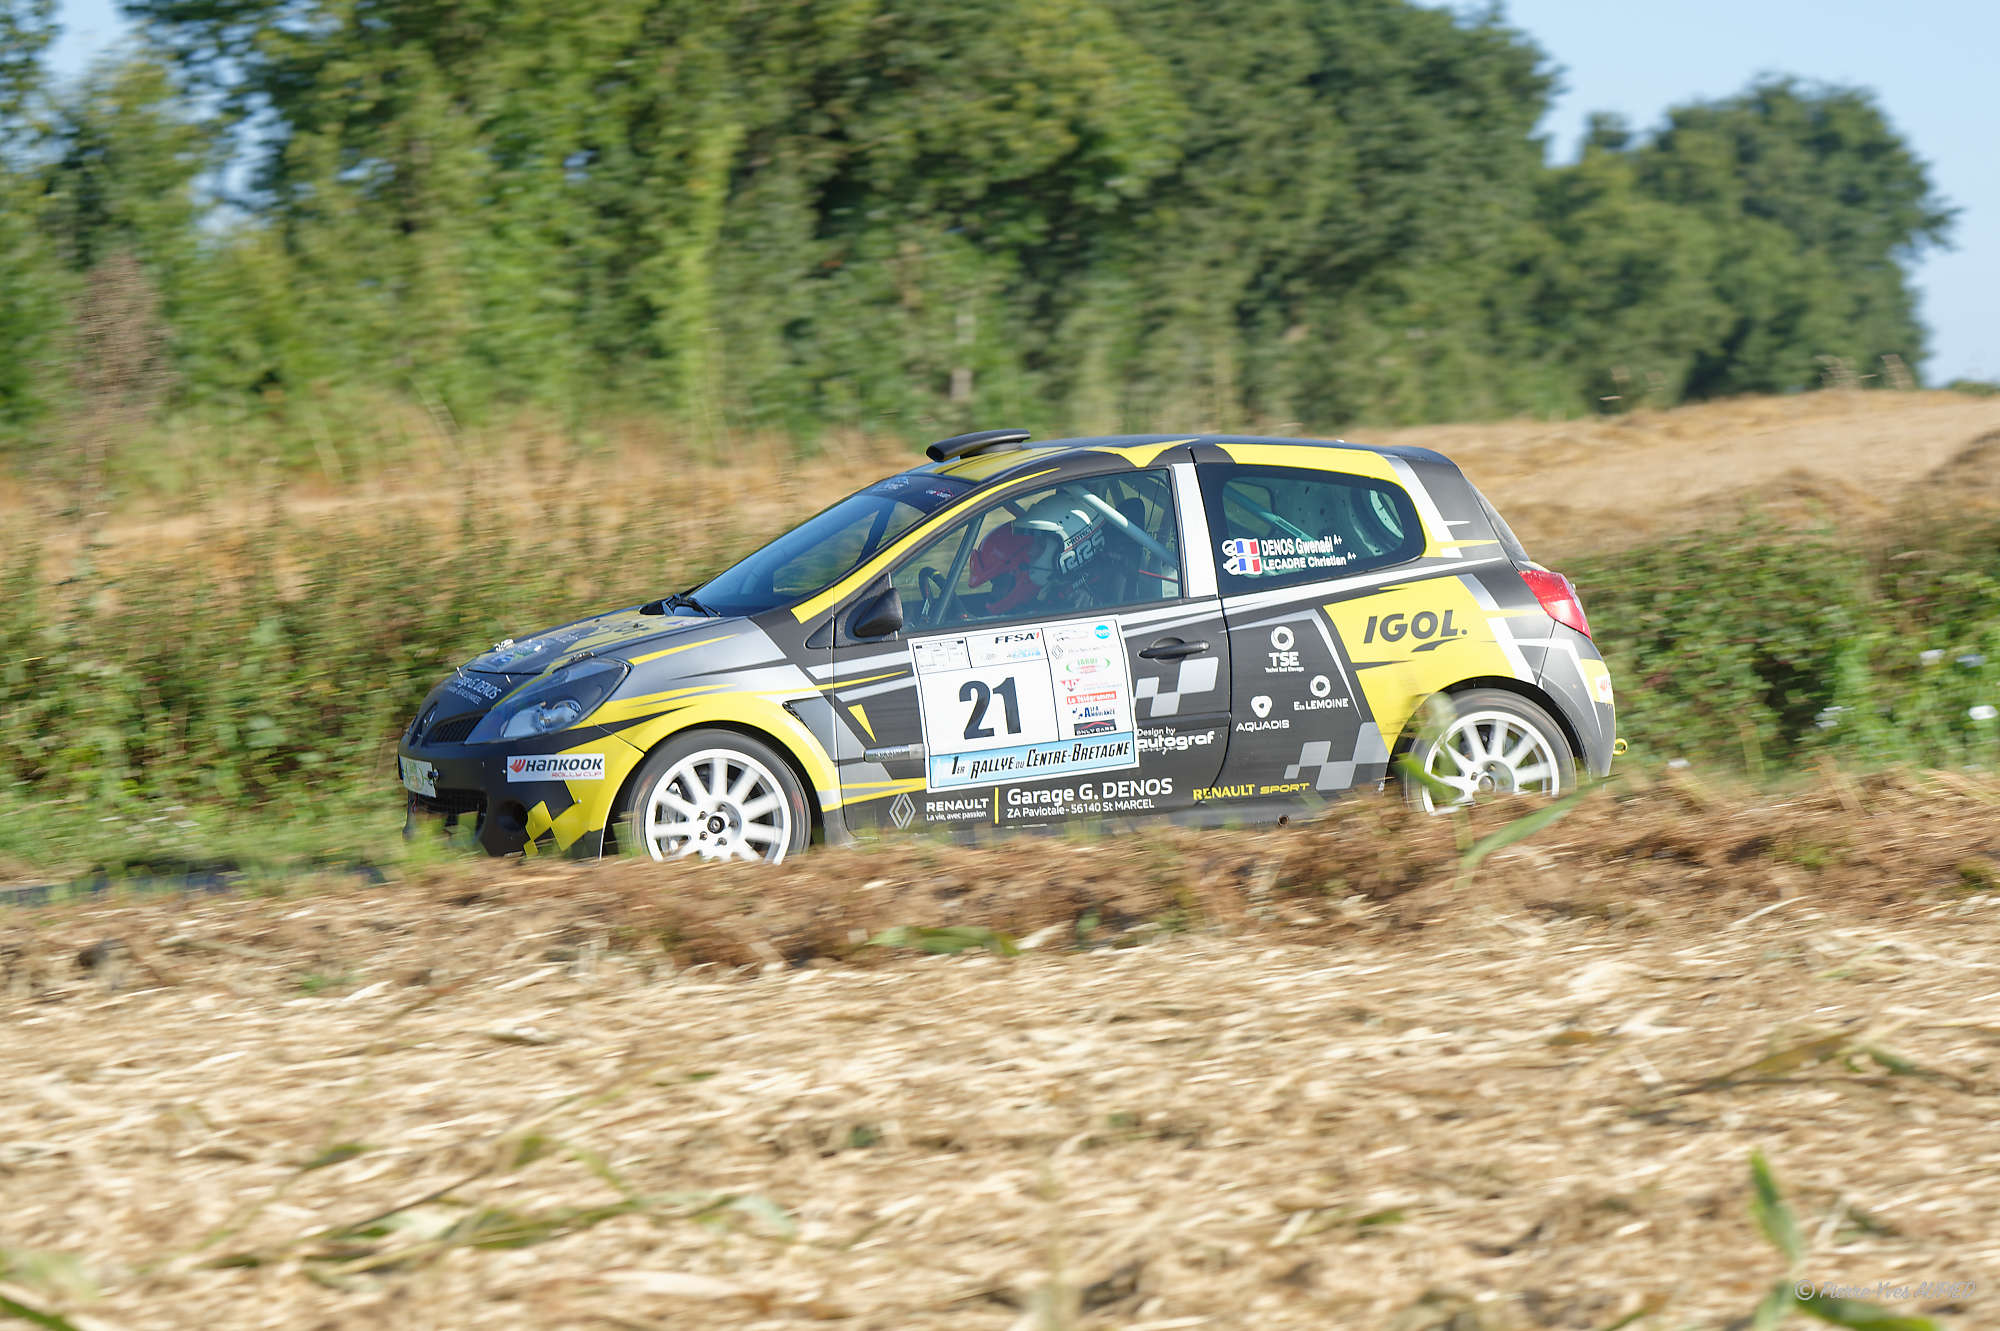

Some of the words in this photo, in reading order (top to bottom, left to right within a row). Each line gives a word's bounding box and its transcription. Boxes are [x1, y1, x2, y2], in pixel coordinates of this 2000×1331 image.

[1260, 538, 1295, 556] DENOS
[1263, 557, 1307, 571] LECADRE
[1307, 555, 1347, 568] Christian
[994, 633, 1035, 644] FFSA
[1268, 651, 1300, 667] TSE
[957, 677, 1023, 740] 21
[1305, 697, 1349, 710] LEMOINE
[1136, 728, 1164, 738] Design
[1165, 726, 1177, 736] by
[1235, 719, 1290, 733] AQUADIS
[1136, 731, 1215, 751] autograf
[970, 756, 1016, 780] RALLYE
[1006, 788, 1075, 807] Garage
[1078, 783, 1099, 801] G.
[1102, 777, 1174, 799] DENOS
[1192, 783, 1256, 801] RENAULT
[1259, 782, 1311, 795] SPORT
[926, 797, 990, 812] RENAULT
[1006, 807, 1022, 819] ZA
[1070, 803, 1102, 815] 56140
[1102, 802, 1114, 813] St
[1114, 798, 1156, 812] MARCEL
[946, 811, 962, 820] avec
[961, 810, 987, 821] passion
